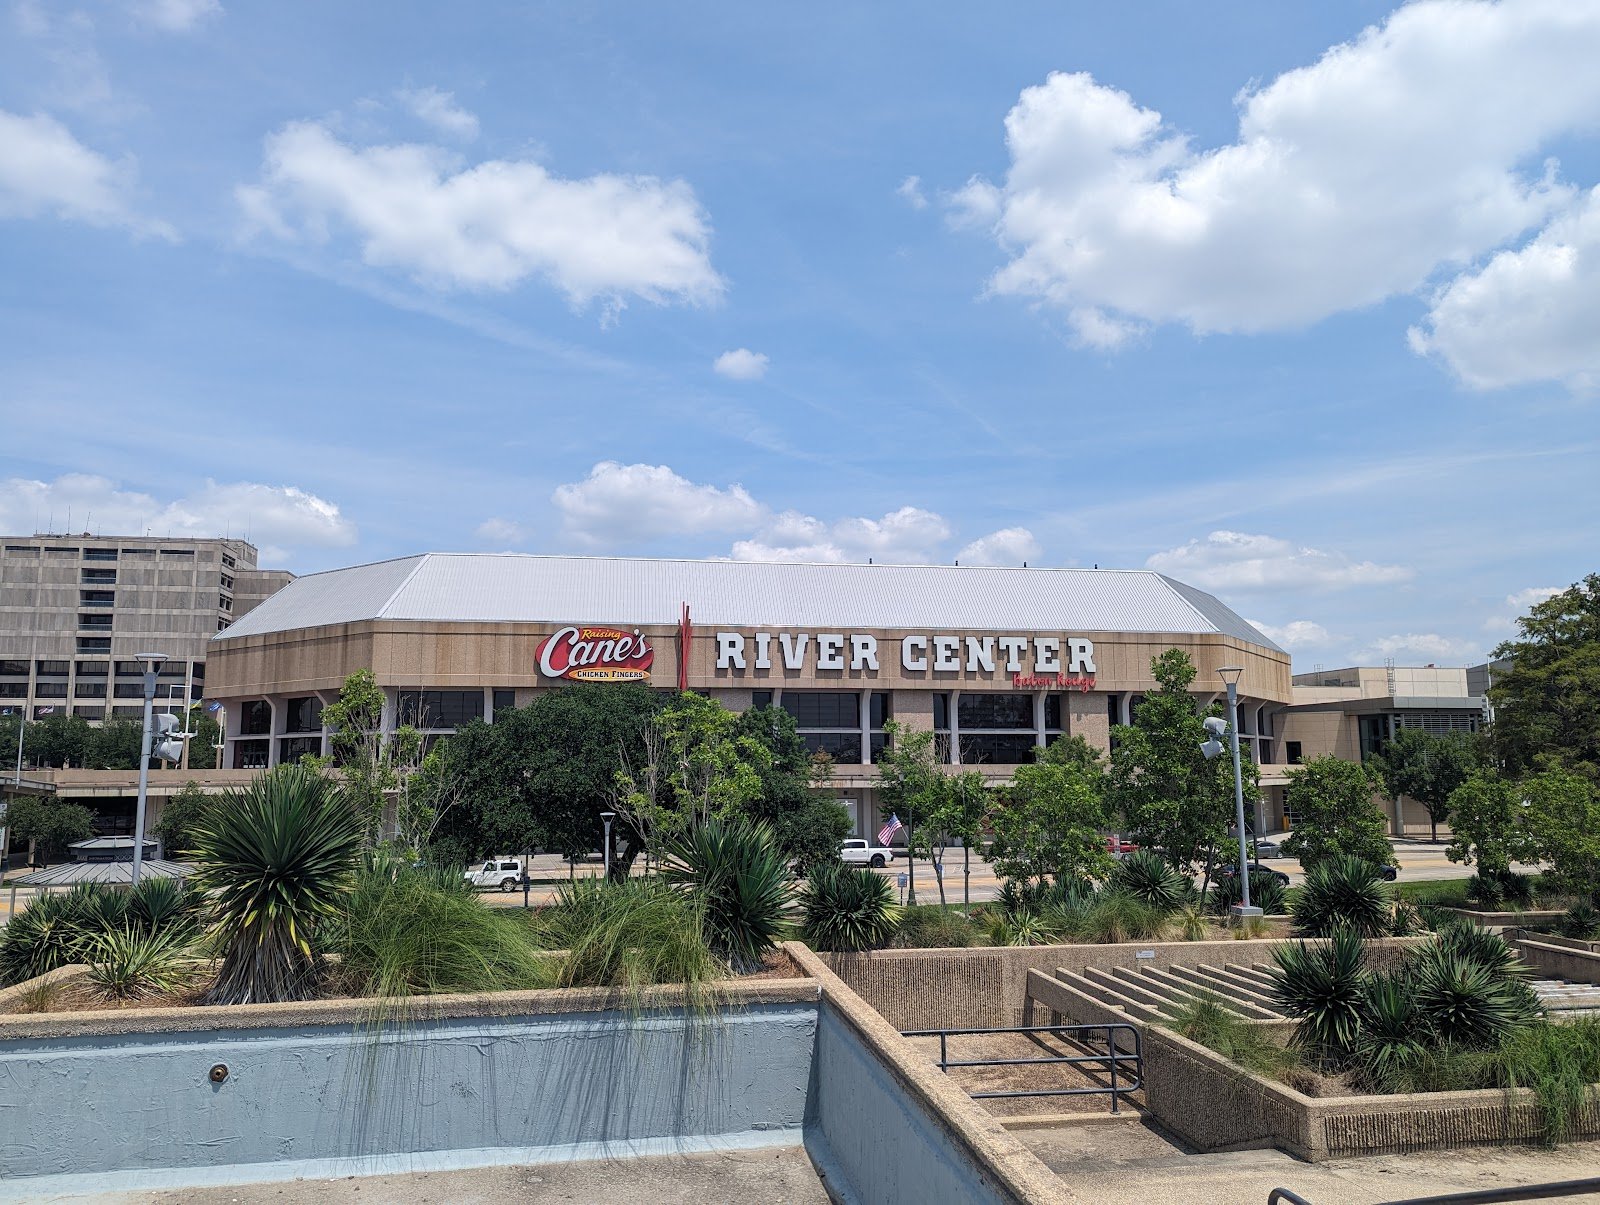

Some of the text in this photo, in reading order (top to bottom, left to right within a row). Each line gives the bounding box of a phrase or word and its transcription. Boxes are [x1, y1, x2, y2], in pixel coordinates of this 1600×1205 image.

[581, 629, 621, 641] Raising
[540, 626, 653, 677] Cane's
[716, 632, 1096, 672] RIVER CENTER
[577, 670, 643, 678] CHICKEN FINGERS
[1013, 672, 1096, 693] Baton Rouge
